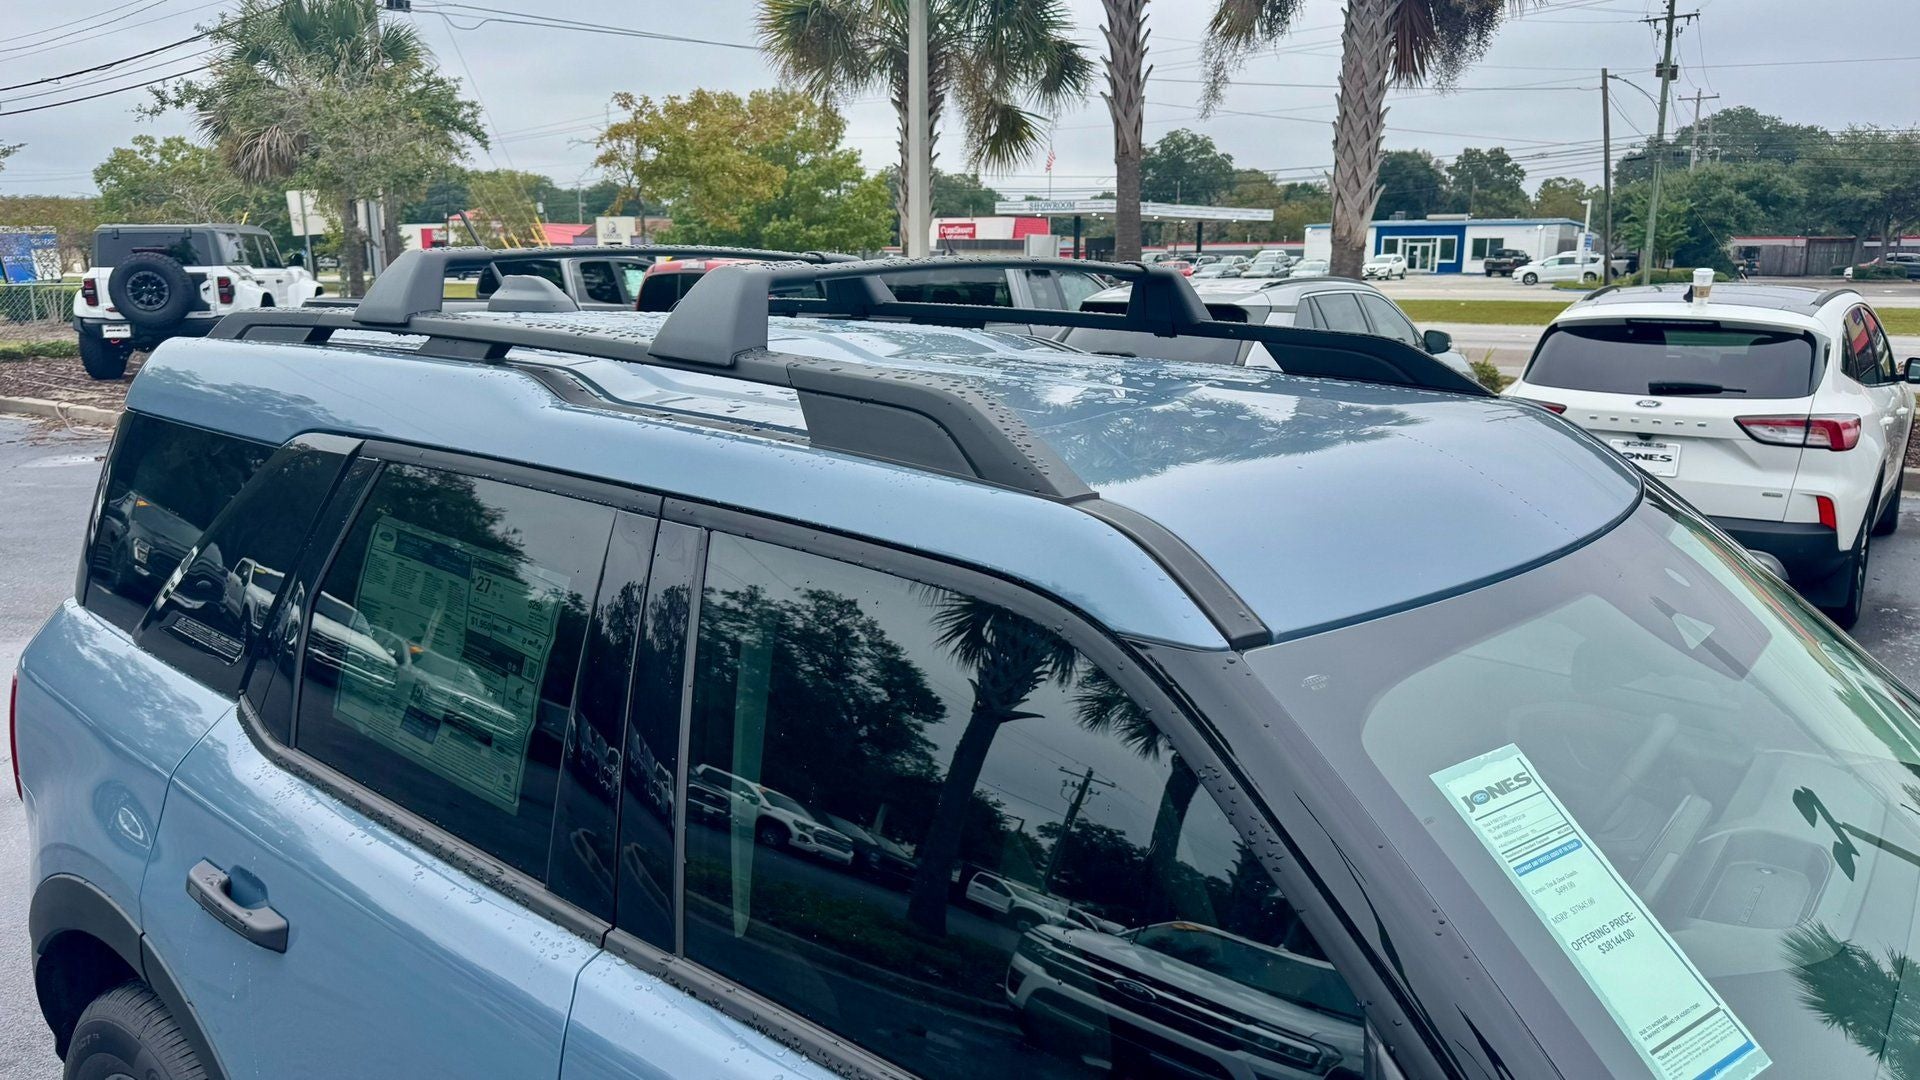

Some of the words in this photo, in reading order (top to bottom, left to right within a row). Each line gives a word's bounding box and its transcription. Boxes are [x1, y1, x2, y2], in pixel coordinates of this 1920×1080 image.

[1622, 452, 1672, 463] ONES
[475, 576, 492, 594] 27
[1459, 771, 1532, 813] JONES
[1571, 924, 1611, 951] OFFERING
[1608, 911, 1637, 931] PRICE:
[1597, 928, 1635, 954] $38144.00
